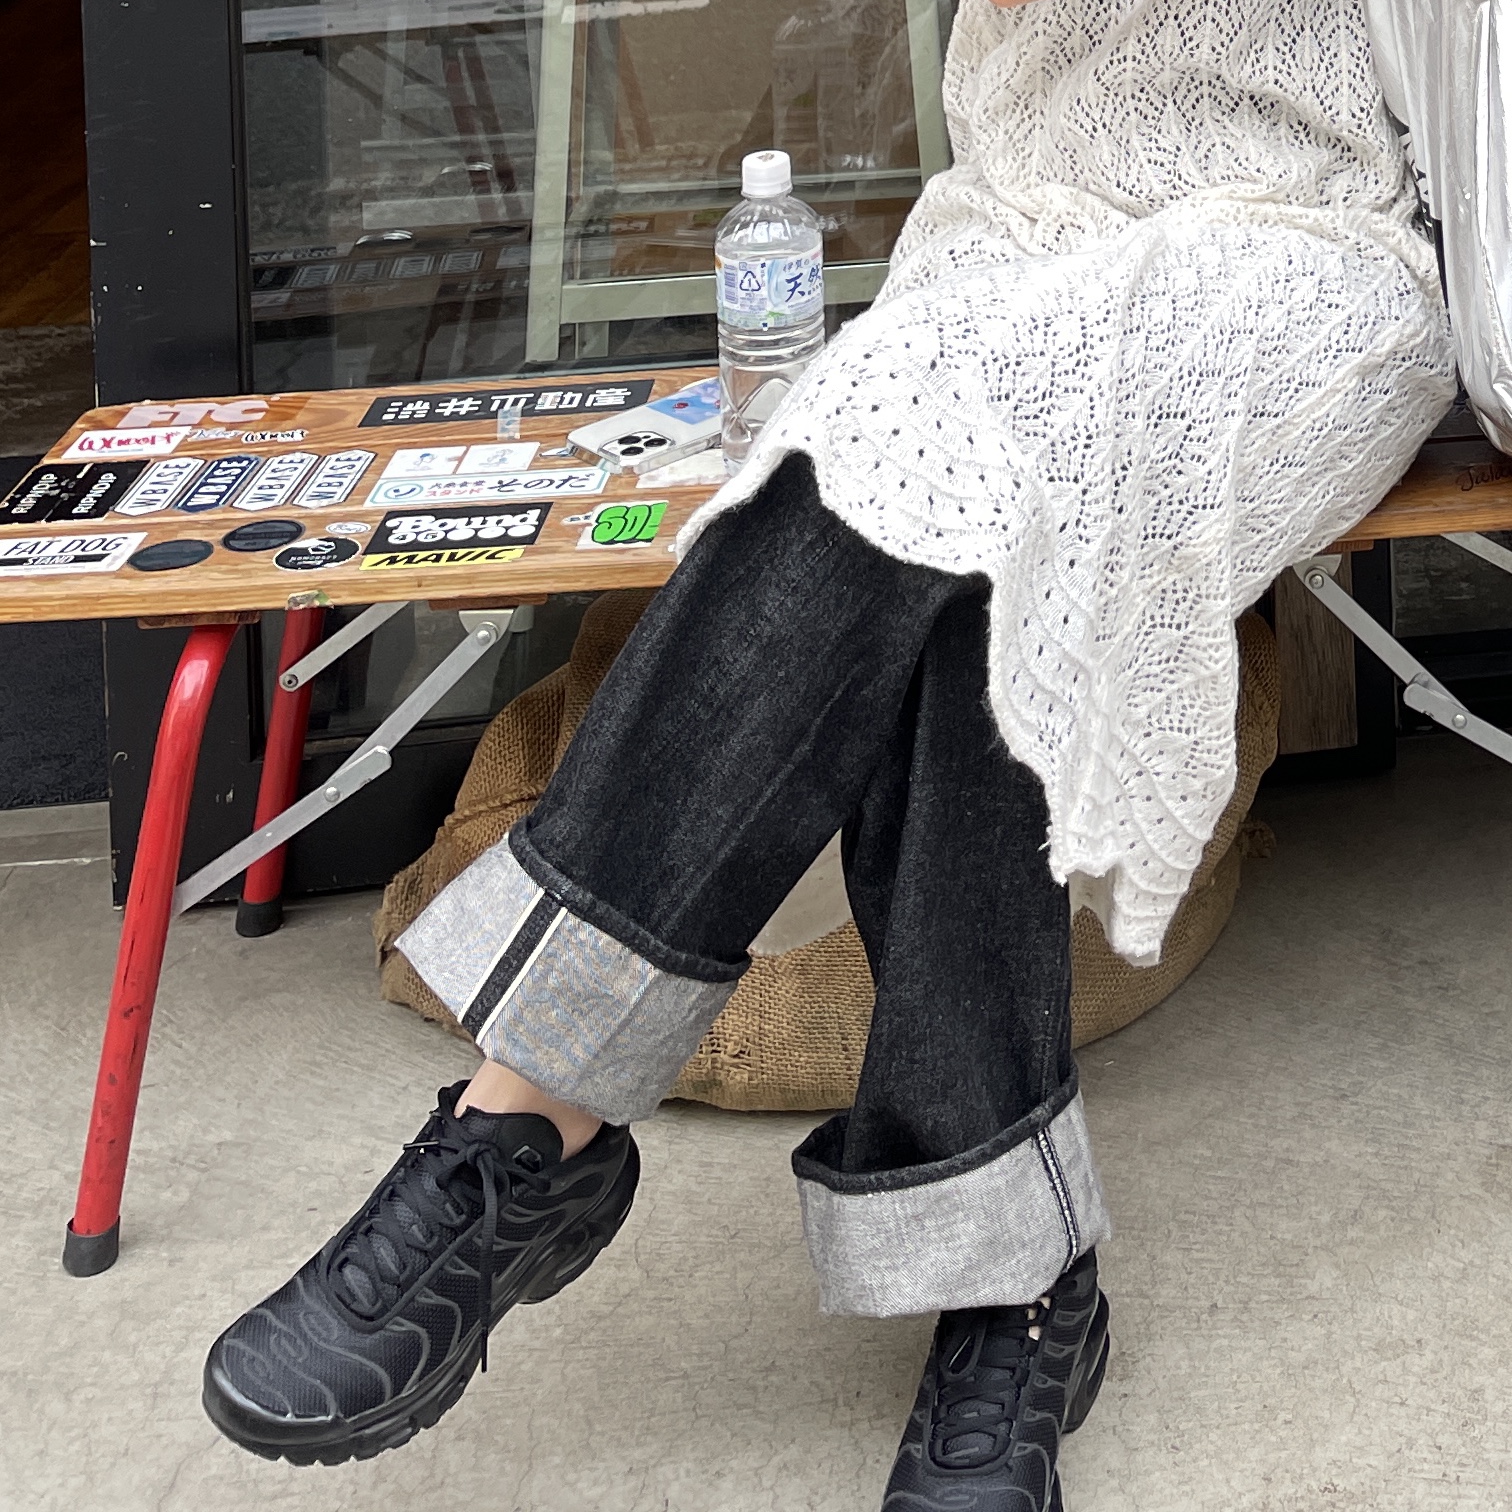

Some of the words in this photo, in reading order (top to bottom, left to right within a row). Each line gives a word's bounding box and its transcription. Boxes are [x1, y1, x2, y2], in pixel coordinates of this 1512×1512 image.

[116, 400, 270, 428] FTC
[487, 473, 595, 493] そのだ
[385, 508, 542, 534] Bound
[3, 540, 60, 556] FAT
[58, 537, 128, 554] DOG
[24, 554, 75, 566] STAND
[368, 548, 517, 568] MAVIC
